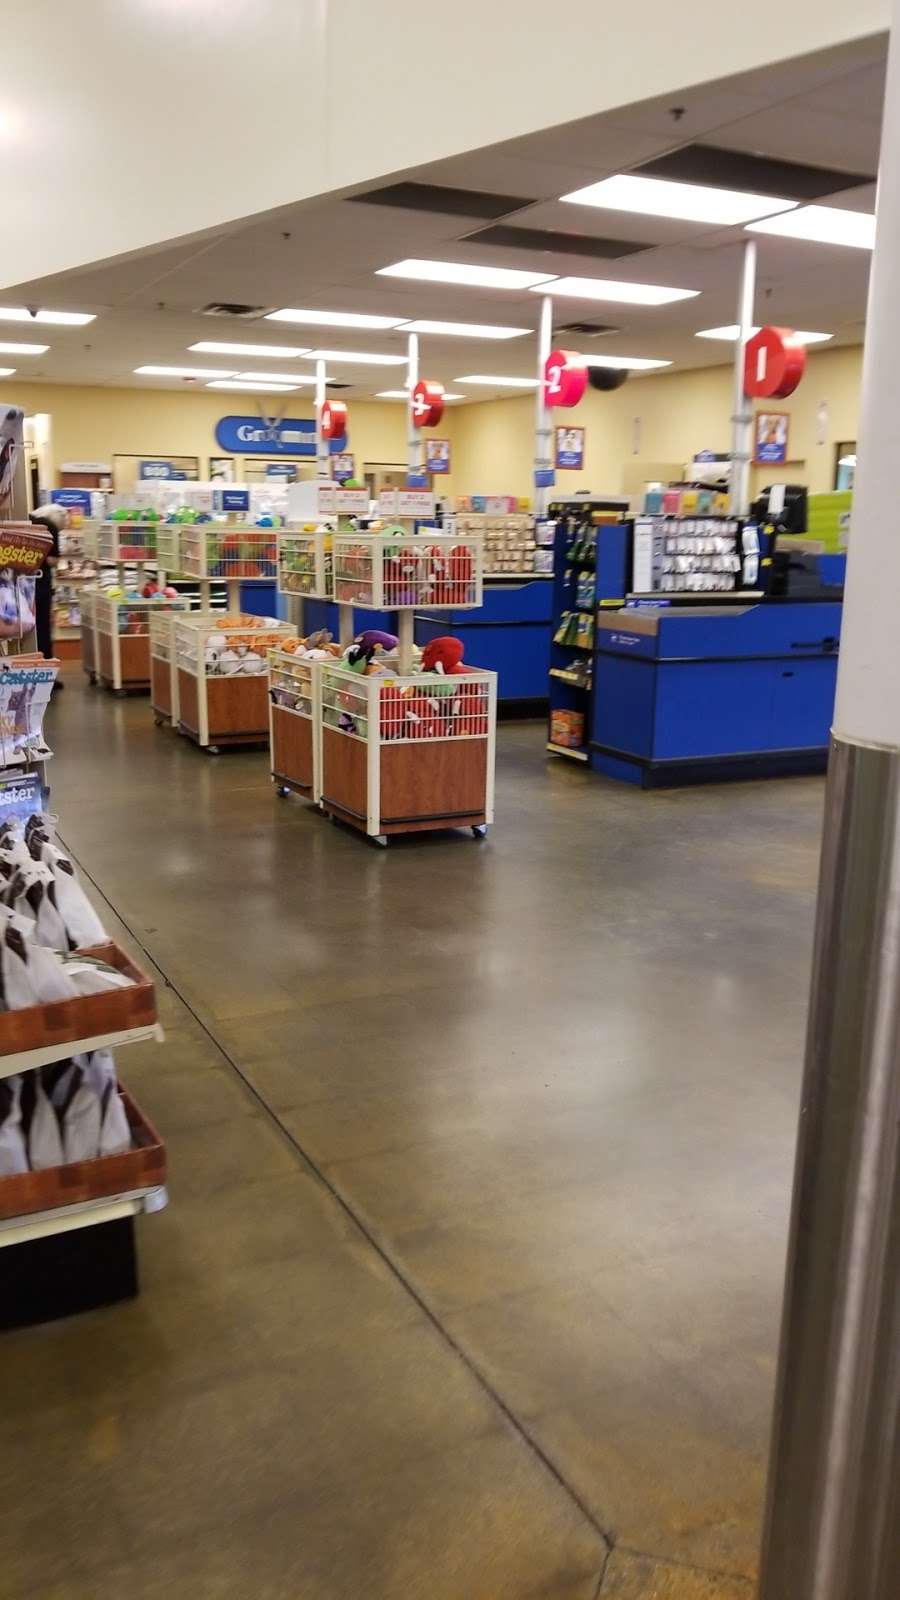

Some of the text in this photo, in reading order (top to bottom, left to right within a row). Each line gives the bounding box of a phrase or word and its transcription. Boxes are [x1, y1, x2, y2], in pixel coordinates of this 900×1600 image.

[756, 346, 768, 382] 1
[548, 365, 562, 393] 2
[0, 545, 44, 566] gster
